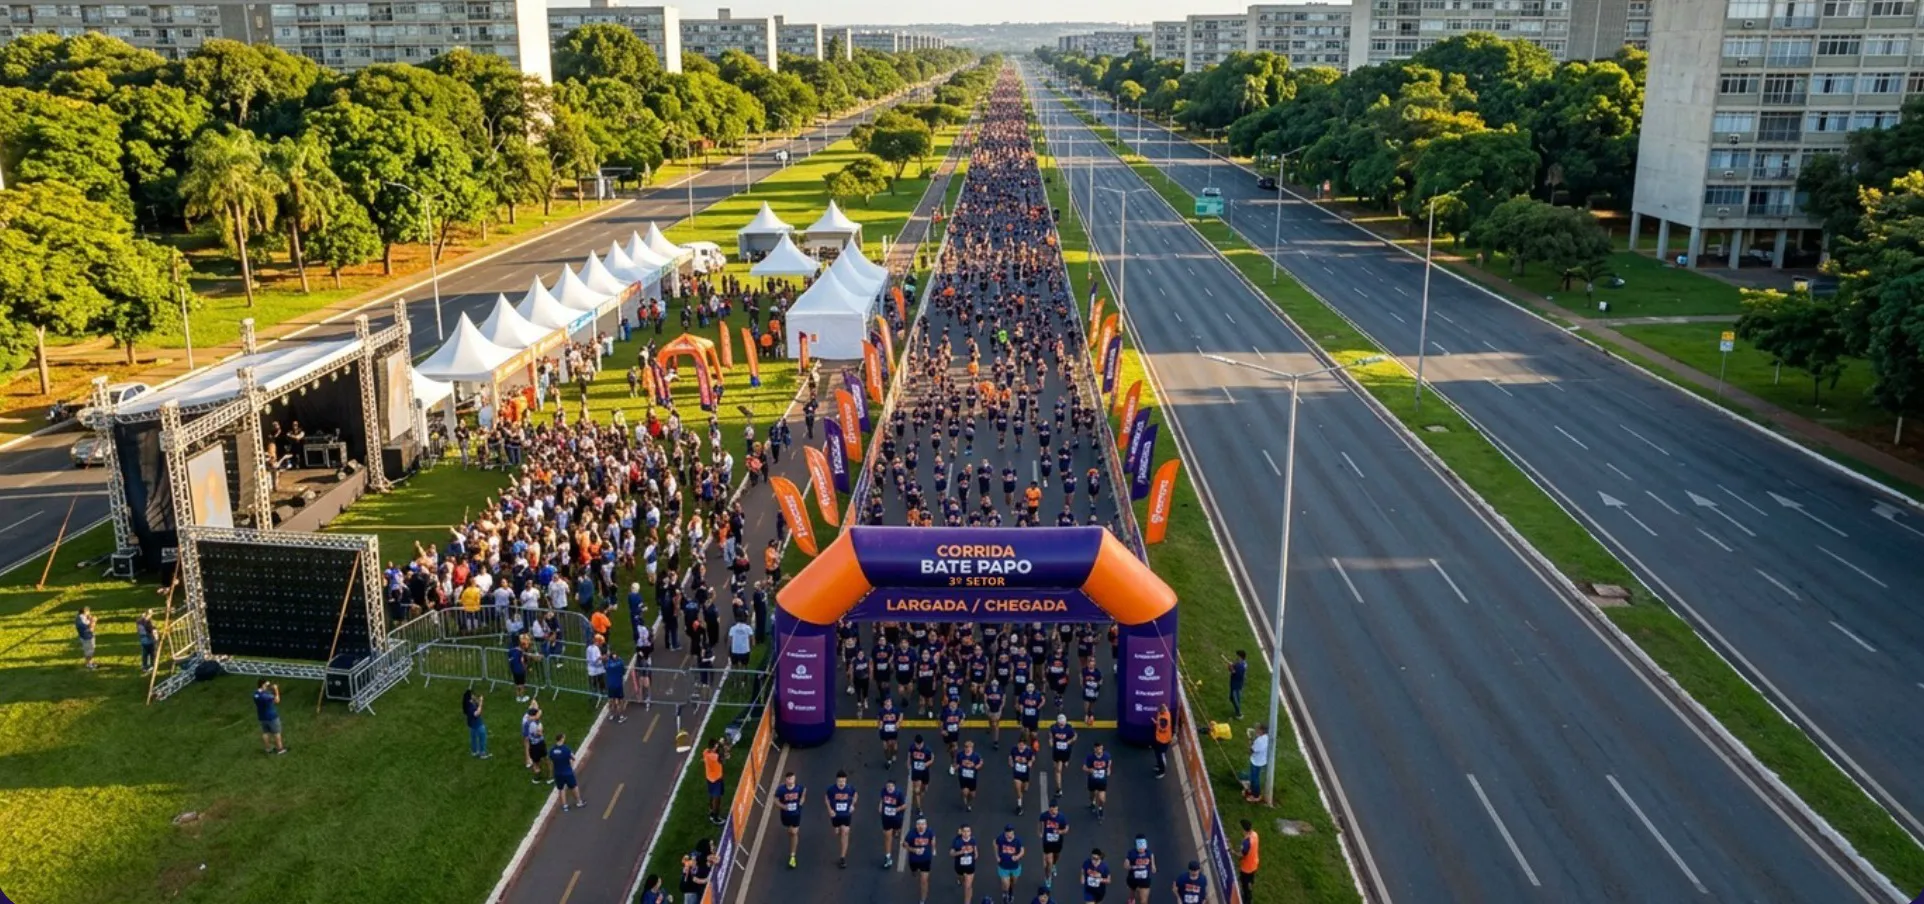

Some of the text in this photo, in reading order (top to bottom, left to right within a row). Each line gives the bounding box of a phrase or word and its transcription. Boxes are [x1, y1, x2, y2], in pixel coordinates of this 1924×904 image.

[937, 545, 1015, 557] CORRIDA
[921, 559, 1032, 574] BATE PAPO
[949, 577, 1005, 586] 3º SETOR
[887, 599, 1067, 613] LARGADA / CHEGADA
